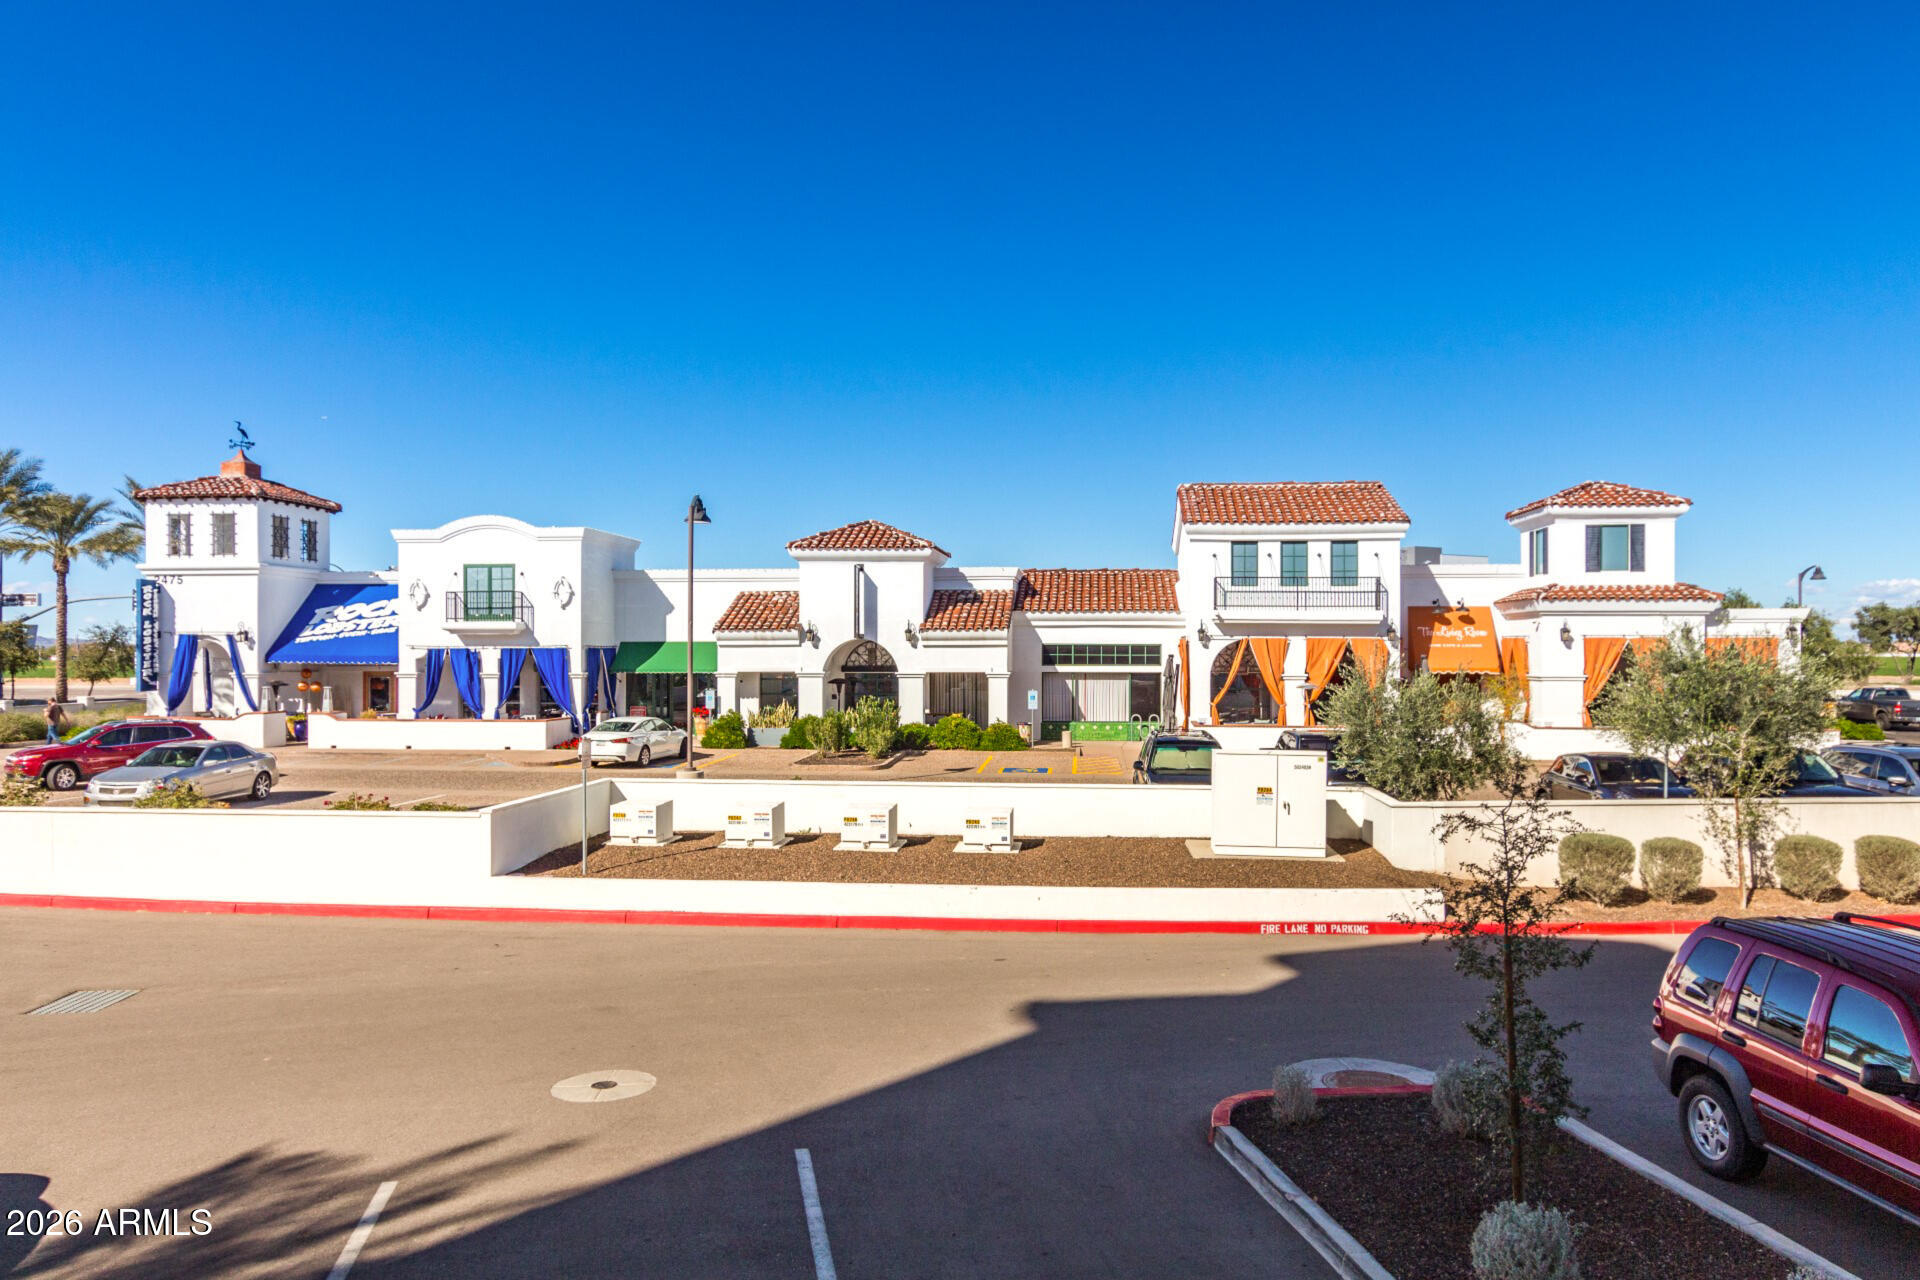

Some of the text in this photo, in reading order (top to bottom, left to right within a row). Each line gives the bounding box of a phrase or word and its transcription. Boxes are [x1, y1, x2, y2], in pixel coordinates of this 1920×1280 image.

[155, 575, 183, 585] 2475
[308, 598, 399, 625] ROCK
[299, 614, 399, 637] LOBSTER
[1440, 625, 1463, 641] Living
[1463, 625, 1488, 638] Room
[1260, 923, 1369, 934] FIRE LANE NO PARKING
